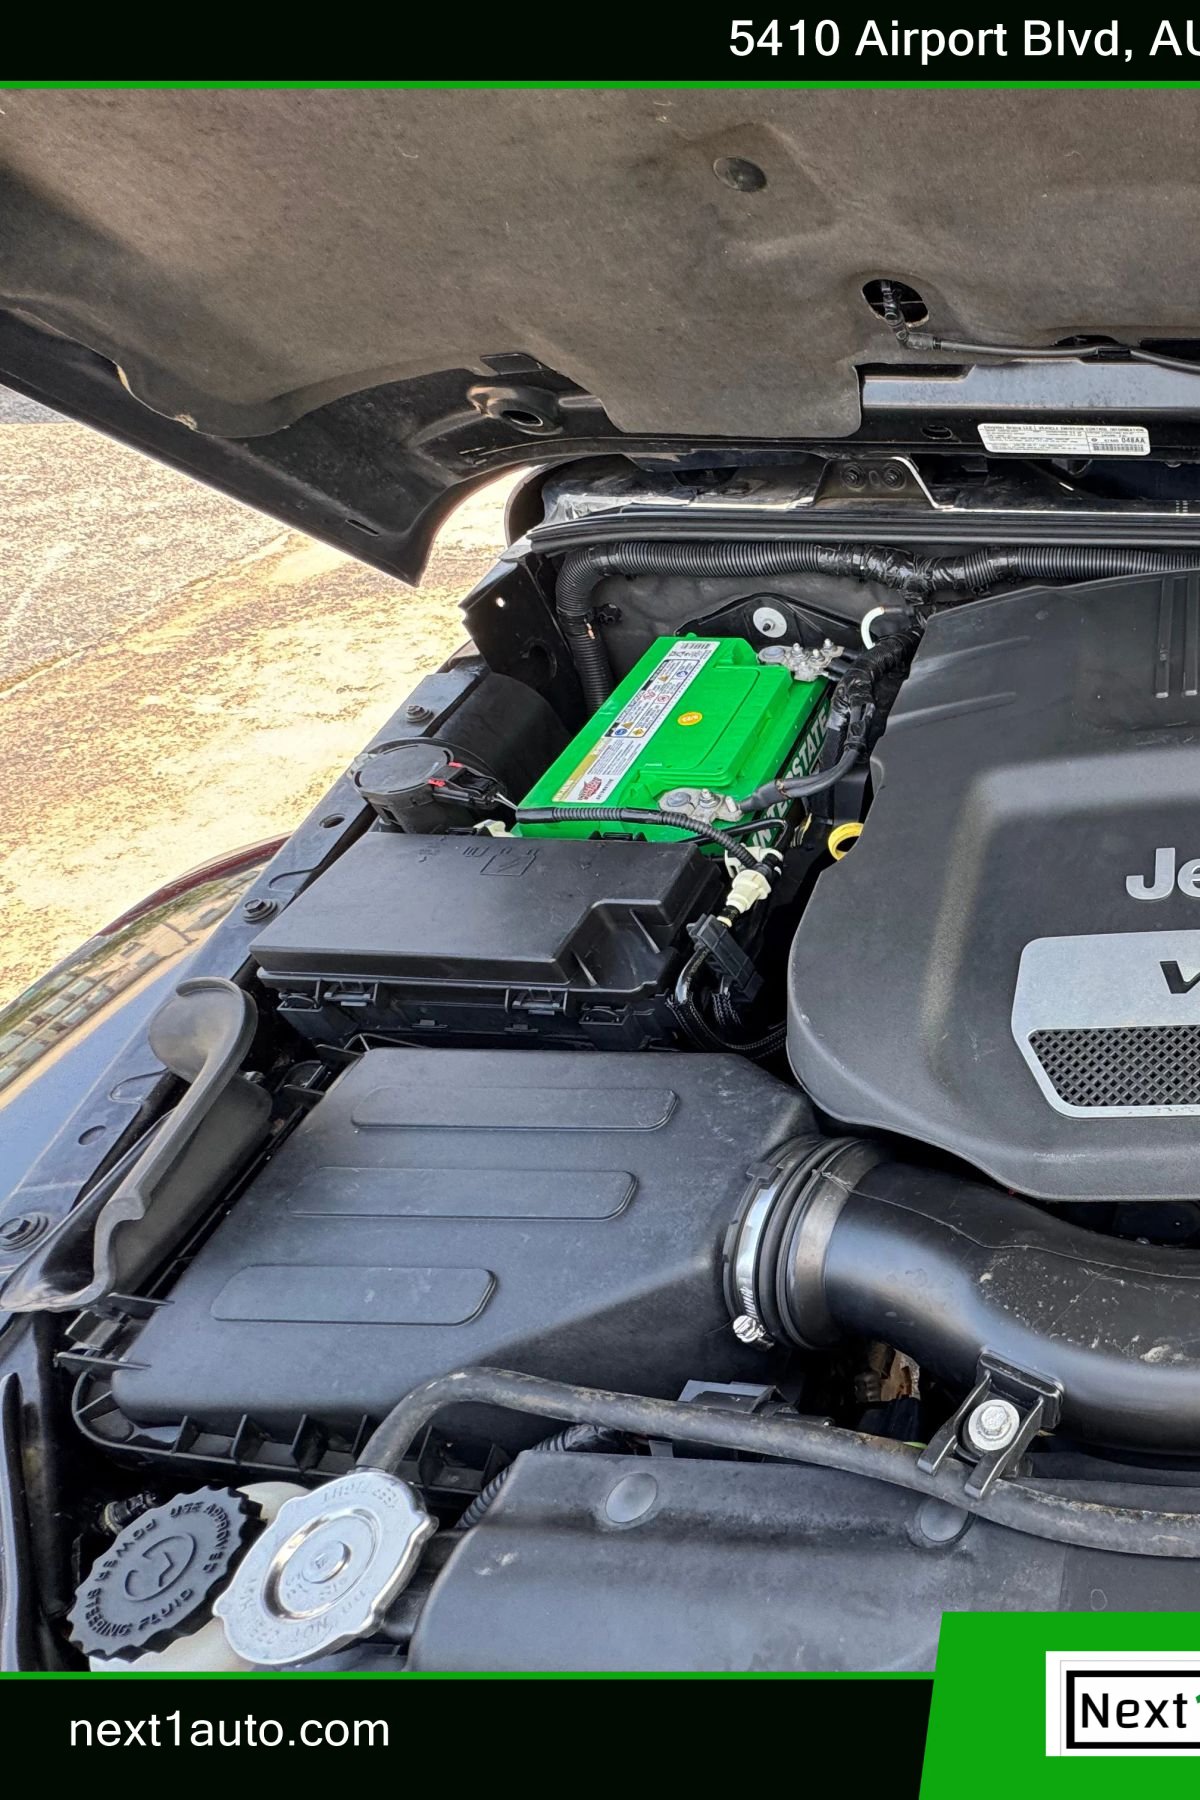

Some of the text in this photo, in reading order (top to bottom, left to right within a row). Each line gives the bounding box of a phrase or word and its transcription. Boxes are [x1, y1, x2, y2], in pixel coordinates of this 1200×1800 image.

[170, 1501, 204, 1519] USE
[85, 1518, 197, 1638] POWER STEERING FLUID
